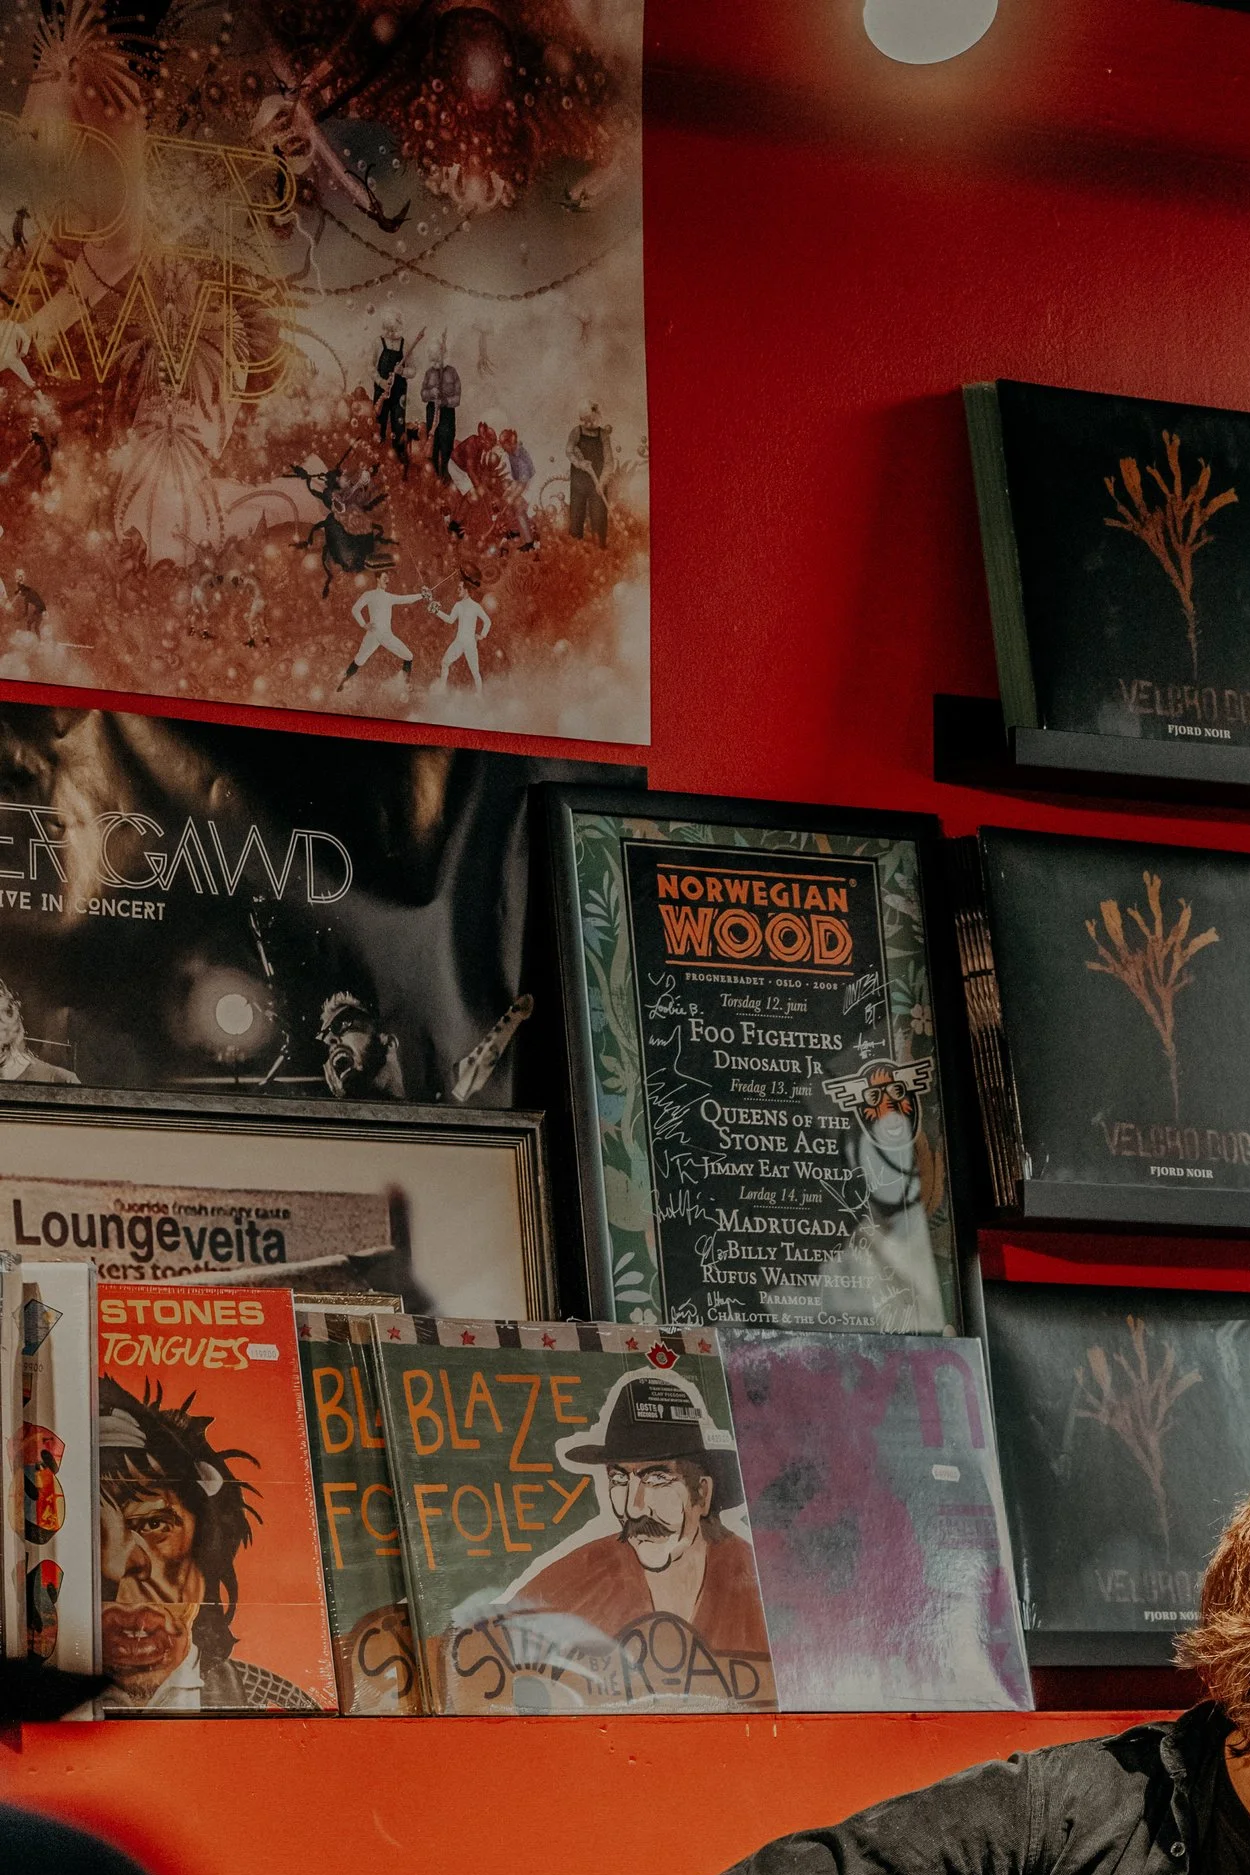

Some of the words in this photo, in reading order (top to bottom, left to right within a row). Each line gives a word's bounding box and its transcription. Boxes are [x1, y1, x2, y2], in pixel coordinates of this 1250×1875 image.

[1167, 724, 1202, 737] FJORD
[1204, 727, 1232, 739] NOIR
[657, 873, 849, 912] NORWEGIAN
[41, 893, 63, 913] IN
[75, 898, 166, 921] CONCERT
[658, 904, 853, 965] WOOD
[685, 972, 765, 986] FROGNERBADET
[776, 978, 802, 988] OSLO
[813, 981, 838, 991] 2008
[720, 993, 761, 1012] Torsdag
[765, 996, 784, 1011] 12.
[785, 998, 808, 1013] juni
[730, 1079, 767, 1097] Fredag
[770, 1081, 788, 1096] 13.
[789, 1083, 813, 1099] juni
[817, 1115, 851, 1130] THE
[1149, 1165, 1185, 1178] FJORD
[1186, 1168, 1214, 1179] NOIR
[739, 1185, 776, 1205] Lørdag
[780, 1188, 798, 1202] 14.
[799, 1190, 823, 1207] juni
[12, 1198, 287, 1264] Loungeveita
[101, 1299, 265, 1326] STONES
[781, 1313, 792, 1324] &
[793, 1316, 815, 1325] THE
[101, 1332, 250, 1369] TONGUES
[403, 1368, 589, 1472] BLAZE
[413, 1476, 590, 1571] FOLEY
[1143, 1610, 1178, 1623] FJORD
[617, 1616, 761, 1703] ROAD
